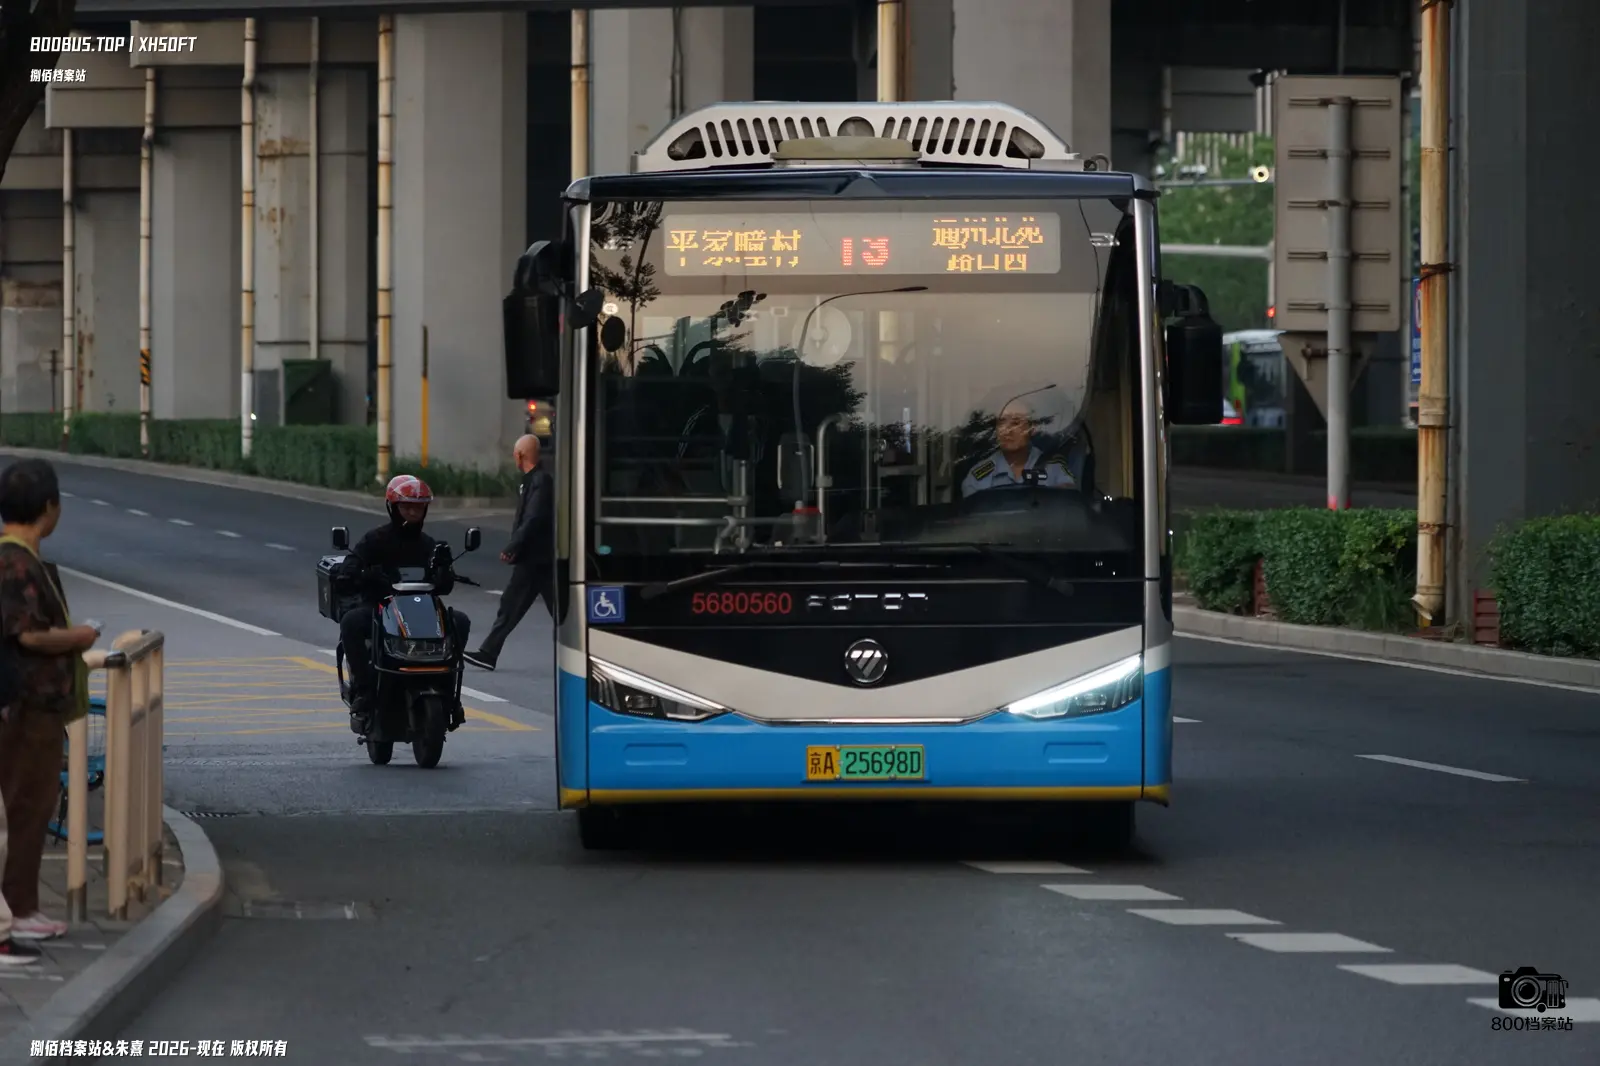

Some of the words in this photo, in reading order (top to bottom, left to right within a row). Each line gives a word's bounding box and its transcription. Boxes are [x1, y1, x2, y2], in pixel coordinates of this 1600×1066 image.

[931, 216, 1045, 249] 通州北苑
[841, 237, 889, 267] 13
[946, 253, 1028, 273] 路口西
[692, 592, 793, 614] 5680560
